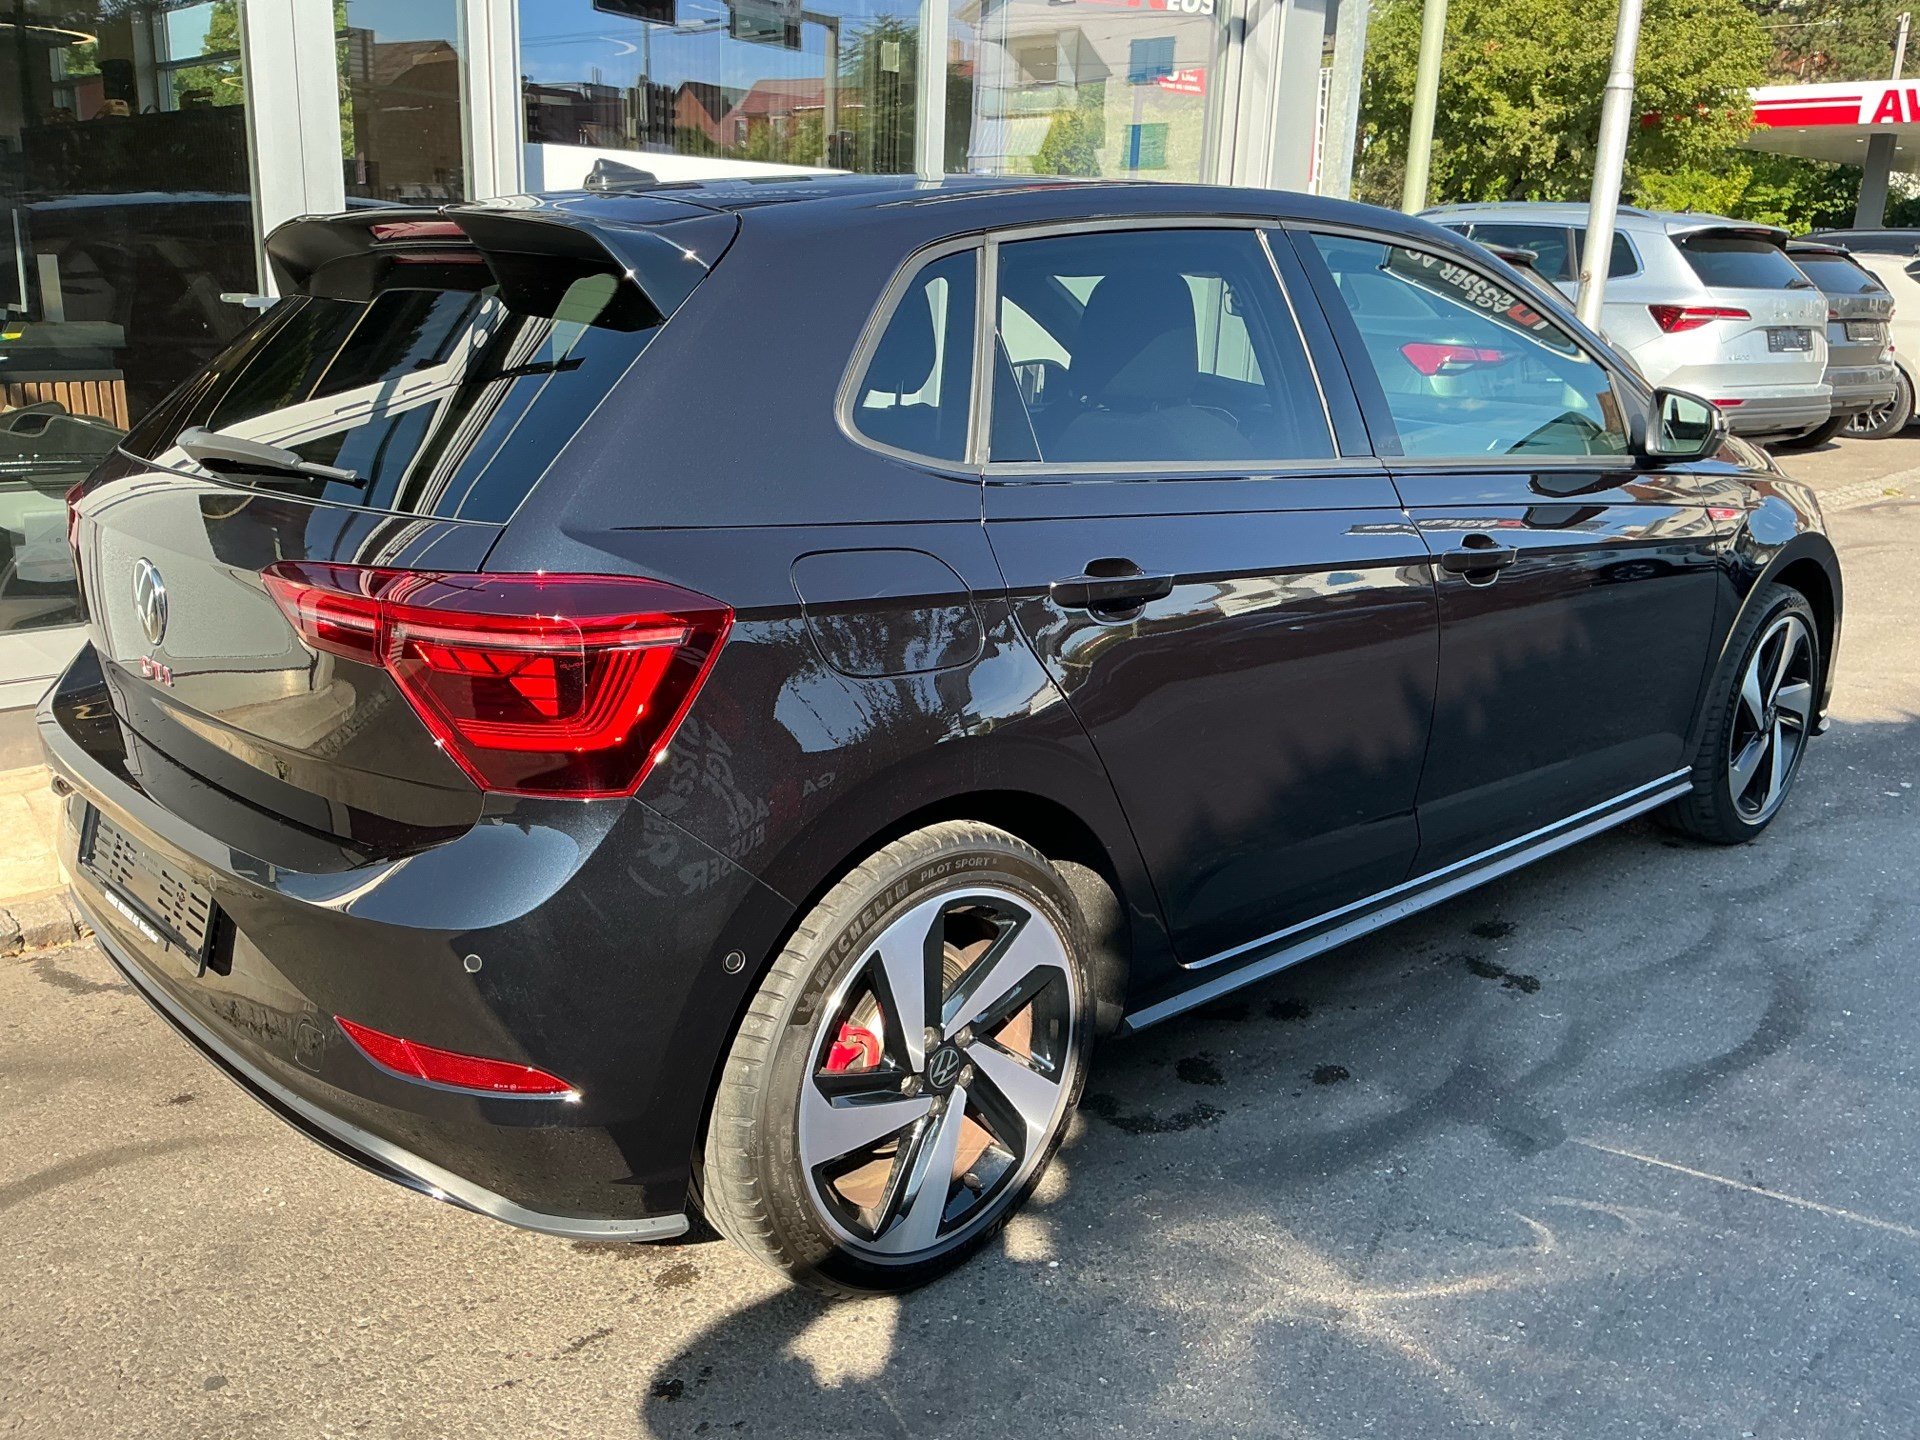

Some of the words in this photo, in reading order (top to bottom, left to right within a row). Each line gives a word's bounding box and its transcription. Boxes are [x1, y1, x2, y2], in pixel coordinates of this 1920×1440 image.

[814, 879, 909, 988] MICHELIN
[920, 861, 952, 882] PILOT
[955, 857, 991, 869] SPORT
